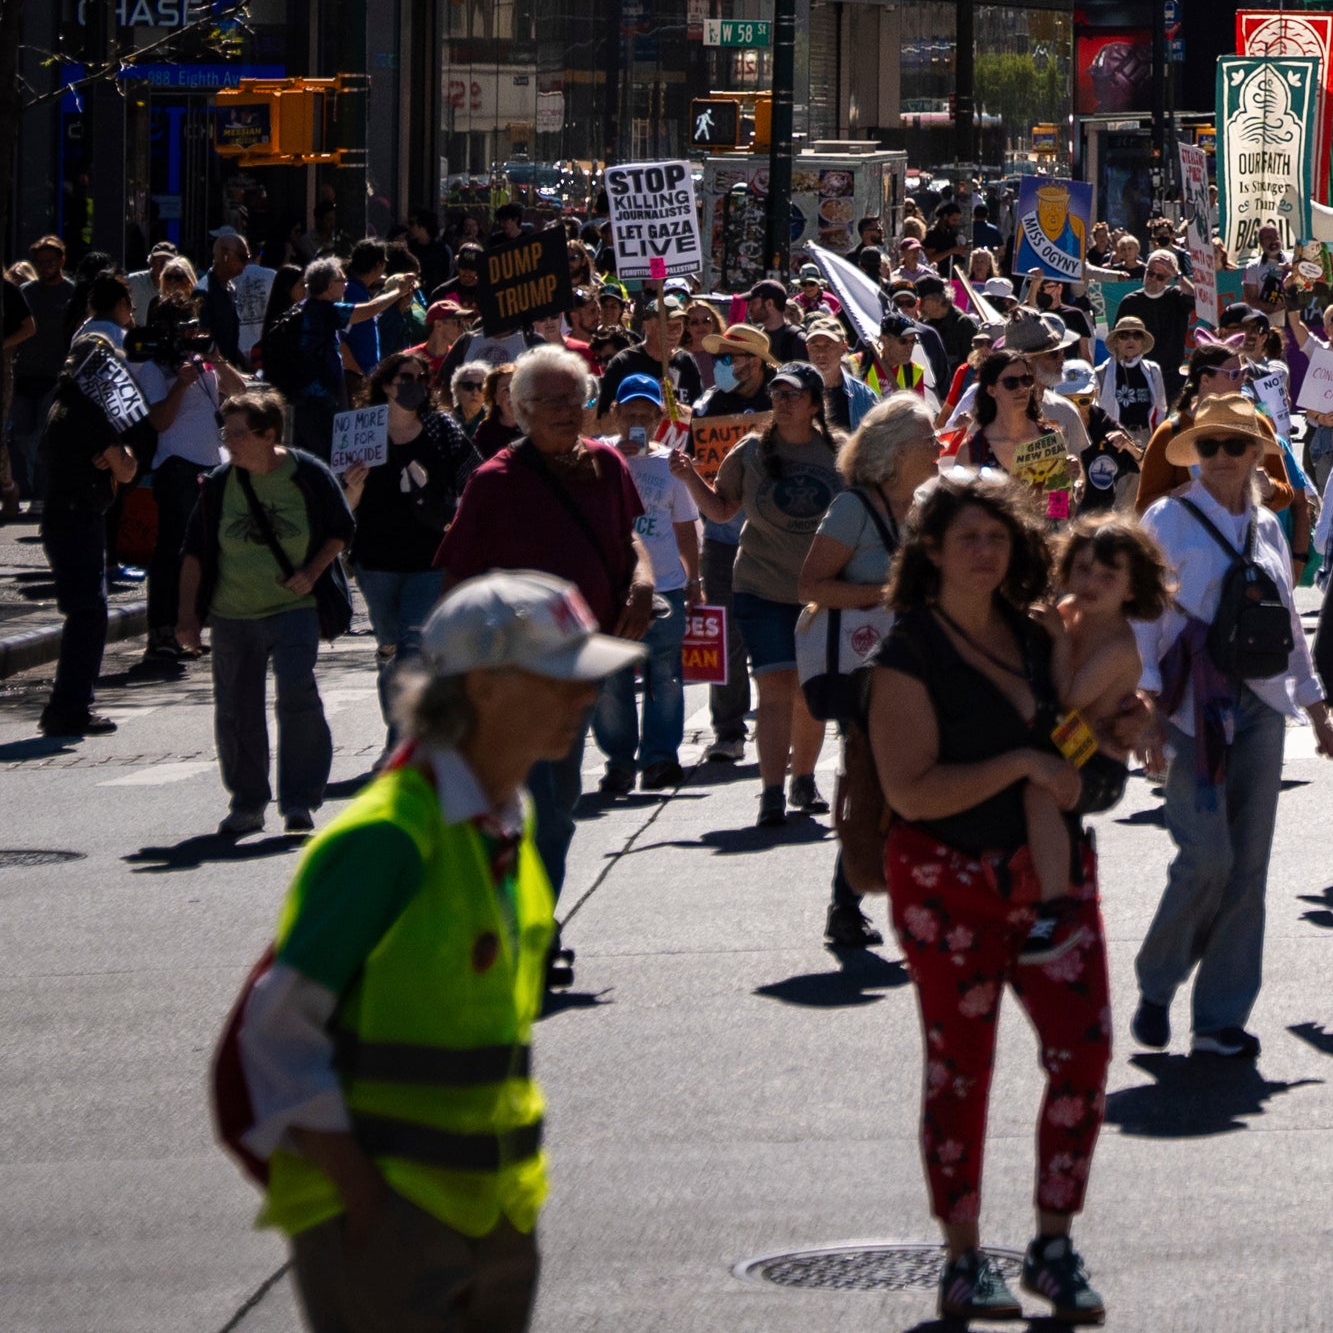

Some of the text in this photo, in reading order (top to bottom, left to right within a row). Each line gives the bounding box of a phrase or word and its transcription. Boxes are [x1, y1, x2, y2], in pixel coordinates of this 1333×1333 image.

[722, 25, 732, 43] W
[738, 24, 752, 43] 58
[608, 165, 685, 195] STOP
[613, 191, 689, 210] KILLING
[615, 205, 691, 221] JOURNALISTS
[616, 220, 693, 241] LET GAZA
[1024, 217, 1045, 247] MISS
[618, 235, 696, 257] LIVE
[488, 242, 543, 285] DUMP
[1042, 246, 1079, 274] OGYNY
[496, 274, 557, 319] TRUMP
[335, 409, 385, 434] NO MORE
[354, 430, 377, 446] FOR
[1027, 433, 1057, 453] GREEN
[1016, 444, 1067, 464] NEW DEAL
